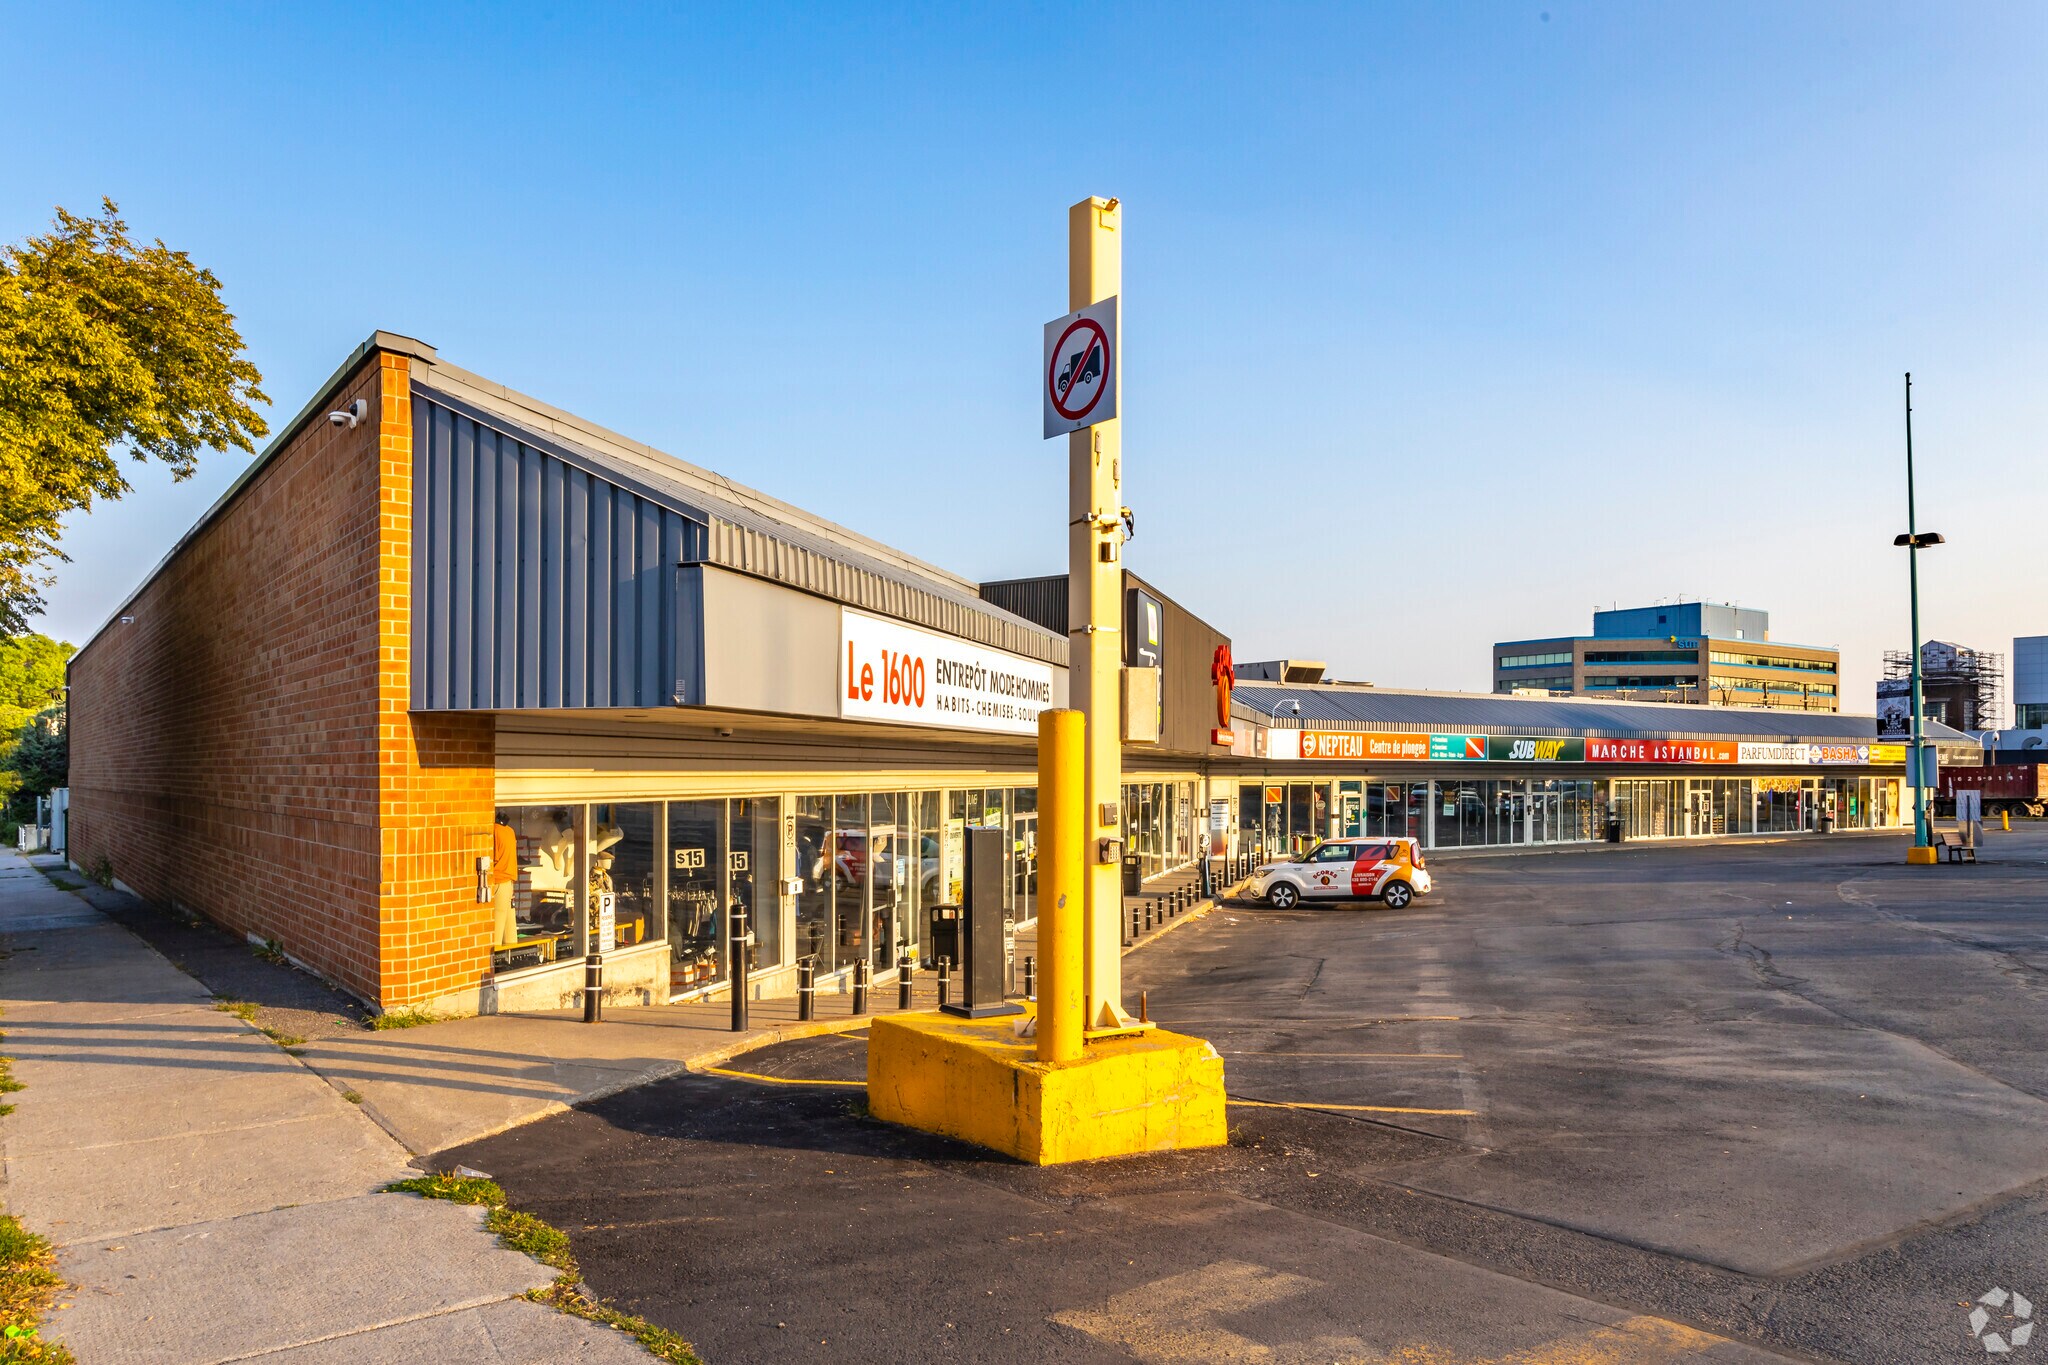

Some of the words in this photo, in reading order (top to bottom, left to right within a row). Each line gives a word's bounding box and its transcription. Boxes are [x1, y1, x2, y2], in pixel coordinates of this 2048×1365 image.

[1678, 640, 1699, 649] stm
[848, 640, 874, 702] Le
[881, 649, 925, 708] 1600
[936, 658, 987, 692] ENTREPÔT
[1318, 735, 1363, 757] NEPTEAU
[1369, 739, 1391, 754] Centre
[1392, 740, 1400, 753] de
[1401, 740, 1426, 758] plongée
[1509, 740, 1565, 759] SUBWAY
[1592, 744, 1645, 759] MARCHE
[1741, 747, 1806, 761] PARFUMDIRECT
[1821, 747, 1859, 761] BASHA
[729, 853, 746, 869] 15
[1312, 870, 1338, 879] SCORES
[603, 897, 611, 913] P
